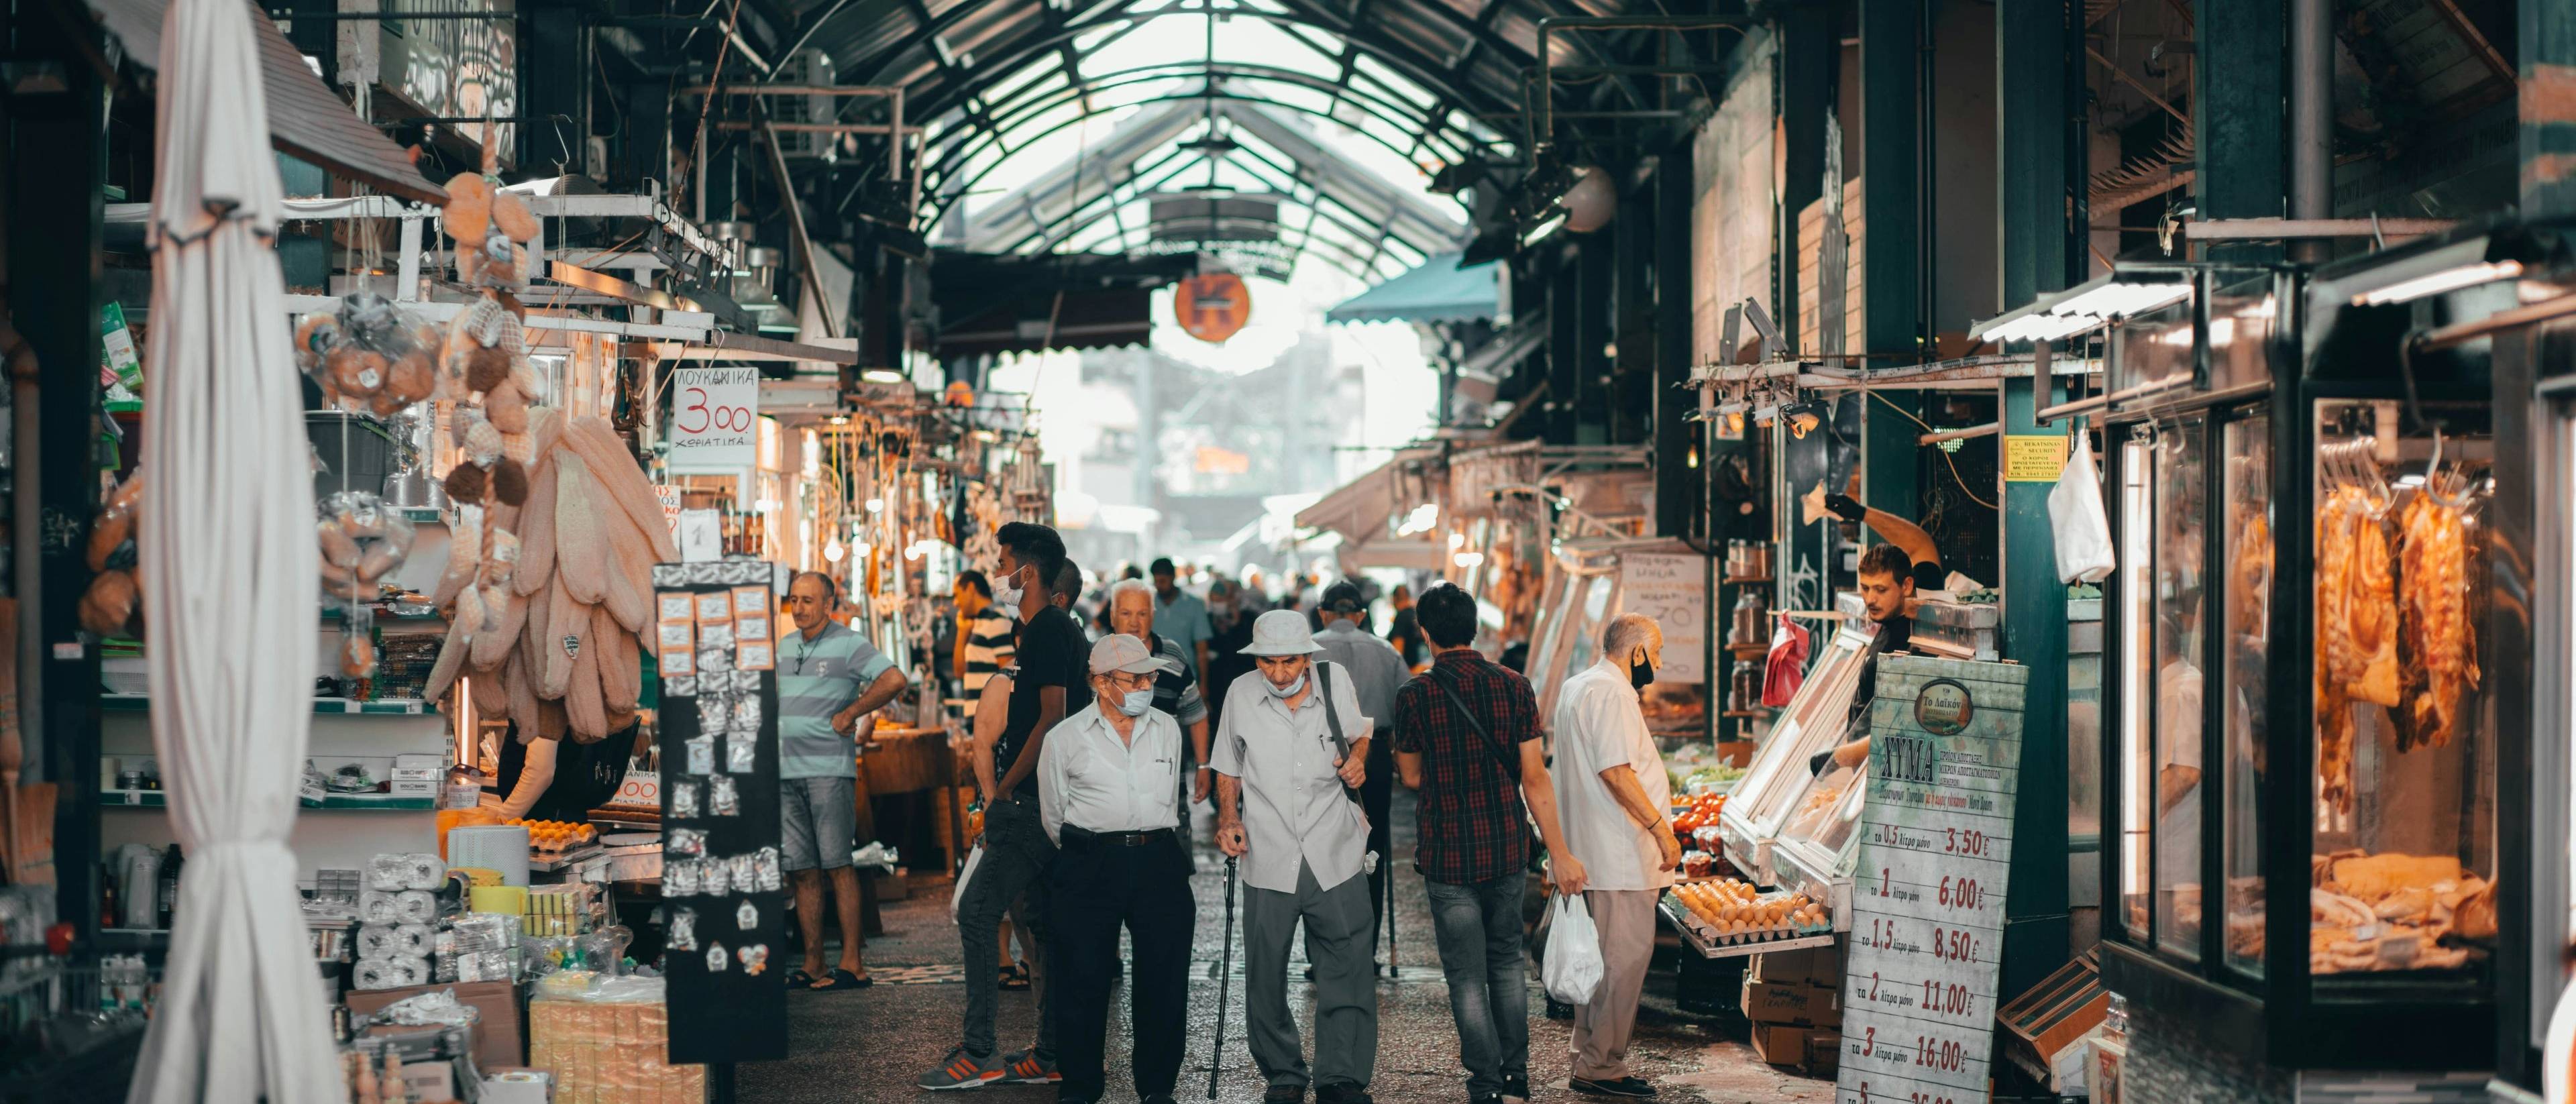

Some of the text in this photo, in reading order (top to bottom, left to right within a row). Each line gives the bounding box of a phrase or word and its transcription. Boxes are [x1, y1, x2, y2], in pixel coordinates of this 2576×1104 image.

[678, 369, 754, 386] ΛΟΥΚΑΝΙΚΑ
[675, 437, 745, 447] ΧΩΡΙΑΤΙΚΑ
[1923, 696, 1962, 709] Το Λαϊκόν
[1880, 735, 1935, 783] ΧΥΜΑ
[1939, 764, 1957, 775] ΜΙΚΡΩΝ
[1957, 753, 1983, 764] ΑΠΟΣΤΑΞΗΣ
[1875, 832, 1882, 843] το
[1884, 824, 1900, 846] 0,5
[1899, 833, 1915, 850] λίτρο
[1916, 836, 1931, 850] μόνο
[1871, 886, 1878, 896] το
[1880, 868, 1890, 897] 1
[1892, 887, 1907, 903] λίτρο
[1909, 889, 1920, 905] μόνο
[1862, 936, 1870, 946] το
[1872, 918, 1894, 954] 1,5
[1892, 938, 1907, 954] λίτρο
[1907, 940, 1921, 956] μόνο
[1858, 988, 1866, 999] τα
[1870, 971, 1879, 1001] 2
[1880, 989, 1898, 1007] λίτρα
[1898, 993, 1913, 1008] μόνο
[1851, 1044, 1860, 1055] τα
[1862, 1026, 1876, 1057] 3
[1874, 1046, 1891, 1063] λίτρα
[1892, 1049, 1908, 1065] μόνο
